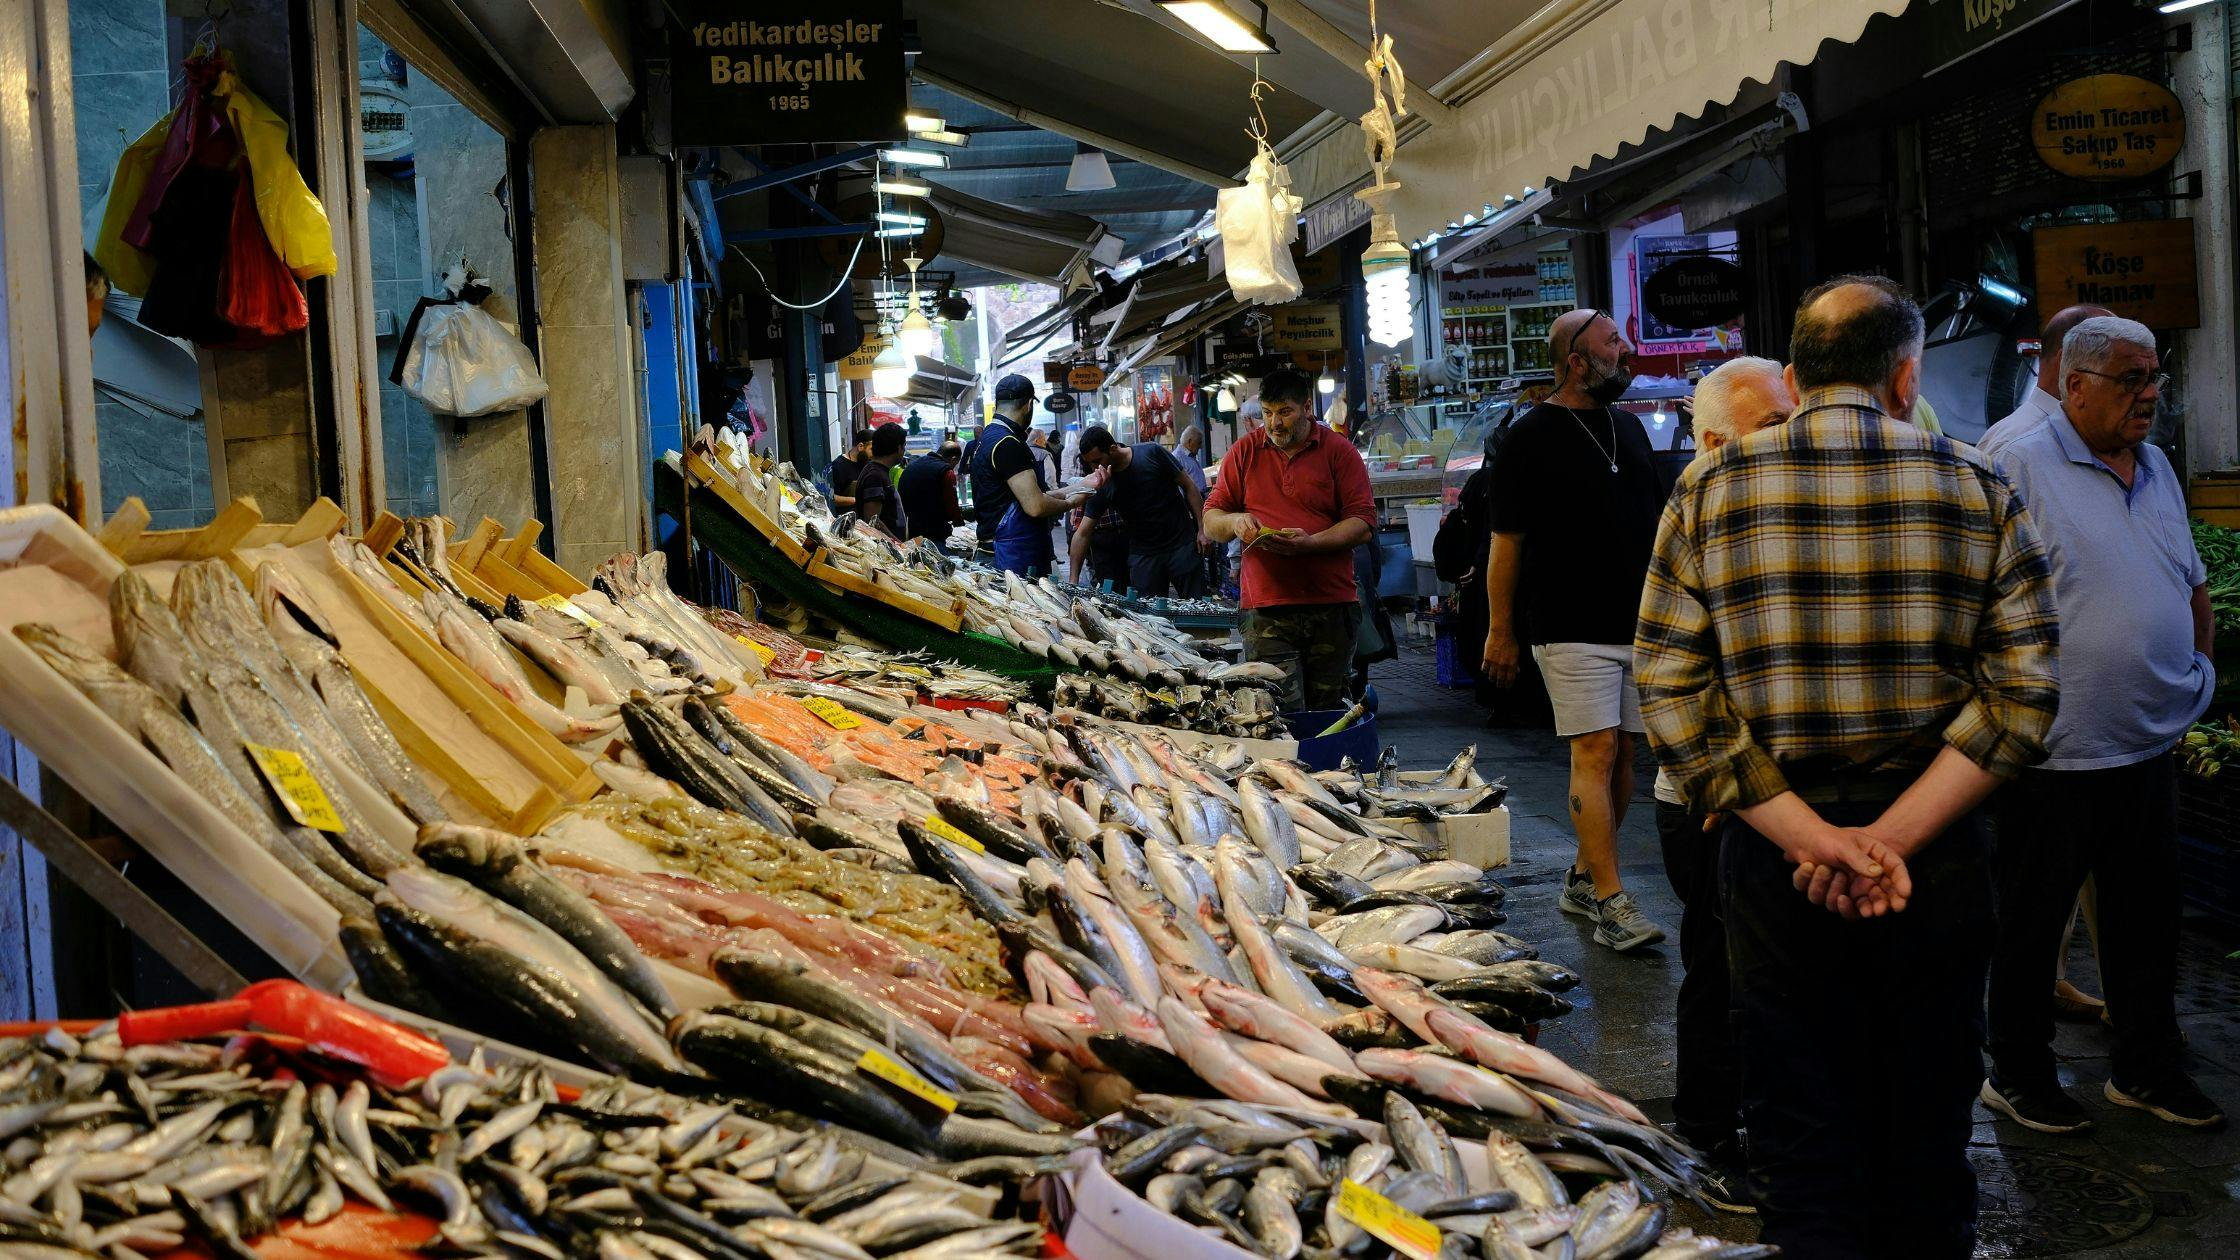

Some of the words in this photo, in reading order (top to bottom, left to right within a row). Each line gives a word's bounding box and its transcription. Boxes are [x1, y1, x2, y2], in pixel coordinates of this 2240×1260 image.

[692, 19, 883, 50] Yedikardeşler
[711, 53, 866, 91] Balıkçılık
[769, 95, 810, 111] 1965
[2046, 111, 2095, 131] Emin
[2100, 105, 2170, 127] Ticaret
[2062, 134, 2118, 156] Sakıp
[2123, 132, 2157, 155] Taş
[2097, 158, 2125, 170] 1960
[2085, 246, 2144, 280] Köşe
[1677, 270, 1719, 287] Örnek
[2078, 283, 2156, 304] Manav
